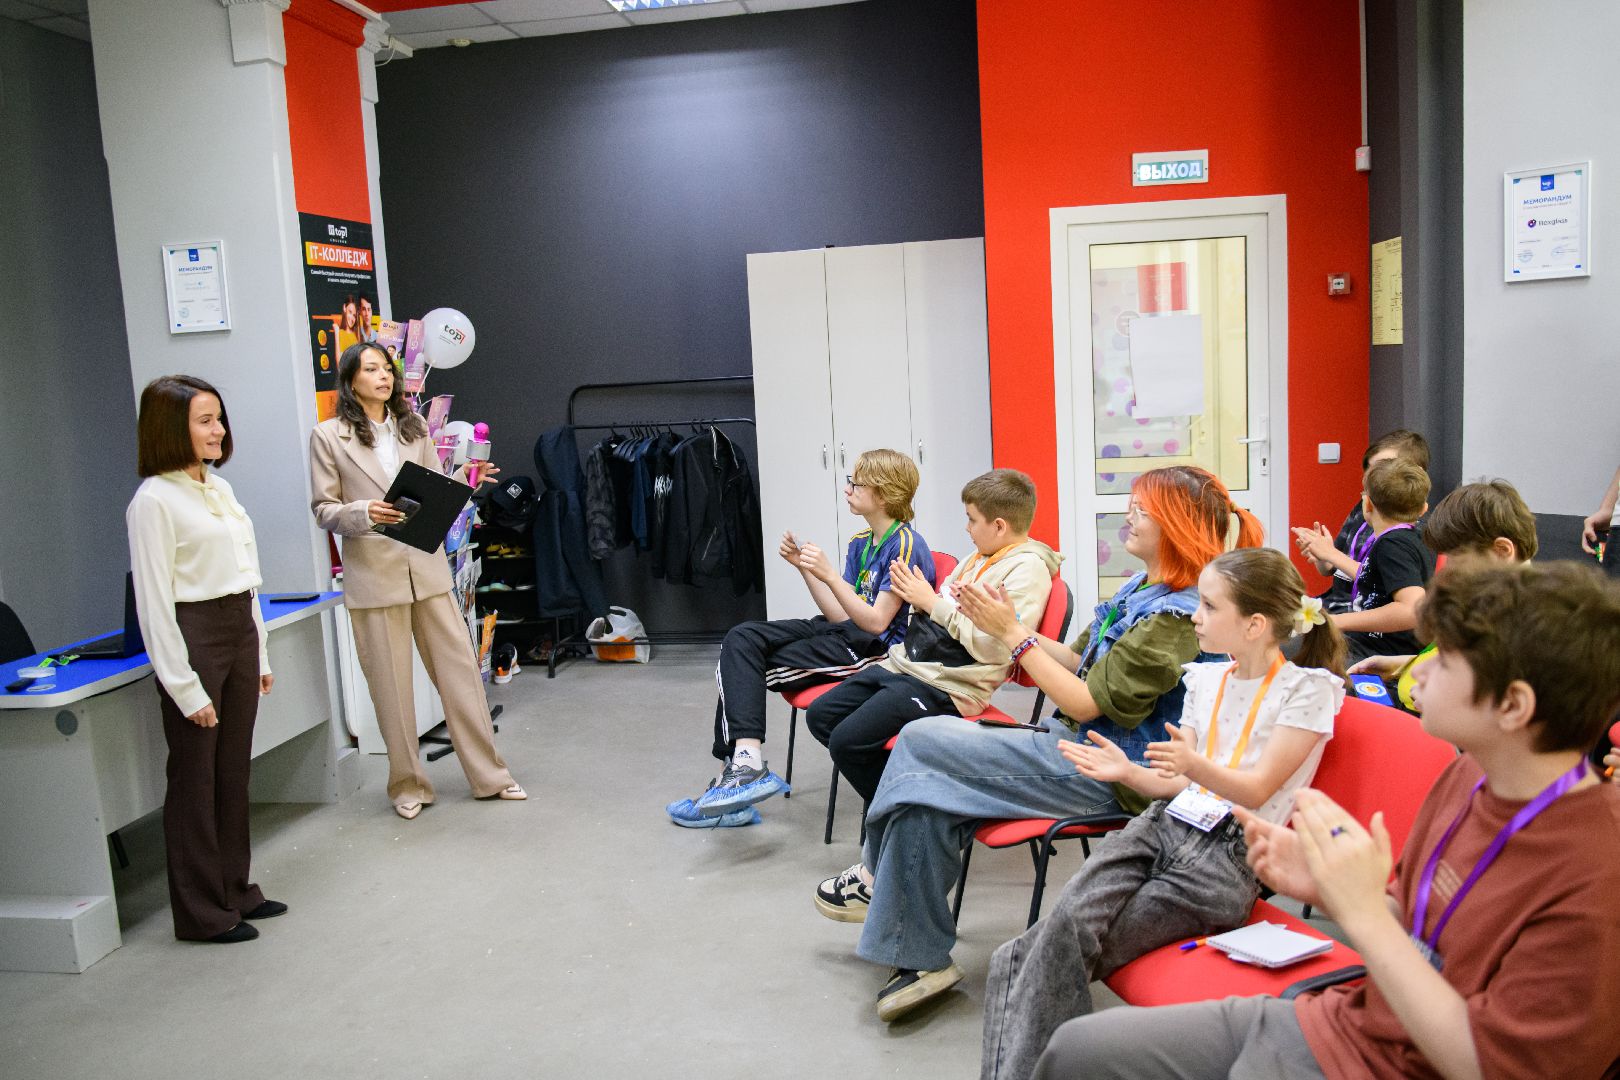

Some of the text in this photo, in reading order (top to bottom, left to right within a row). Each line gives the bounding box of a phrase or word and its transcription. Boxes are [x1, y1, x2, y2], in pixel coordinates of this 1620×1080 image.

[1139, 162, 1201, 181] ВЫХОД
[1523, 194, 1572, 205] МЕМОРАНДУМ
[309, 245, 369, 267] IT-КОЛЛЕДЖ
[444, 324, 462, 341] top
